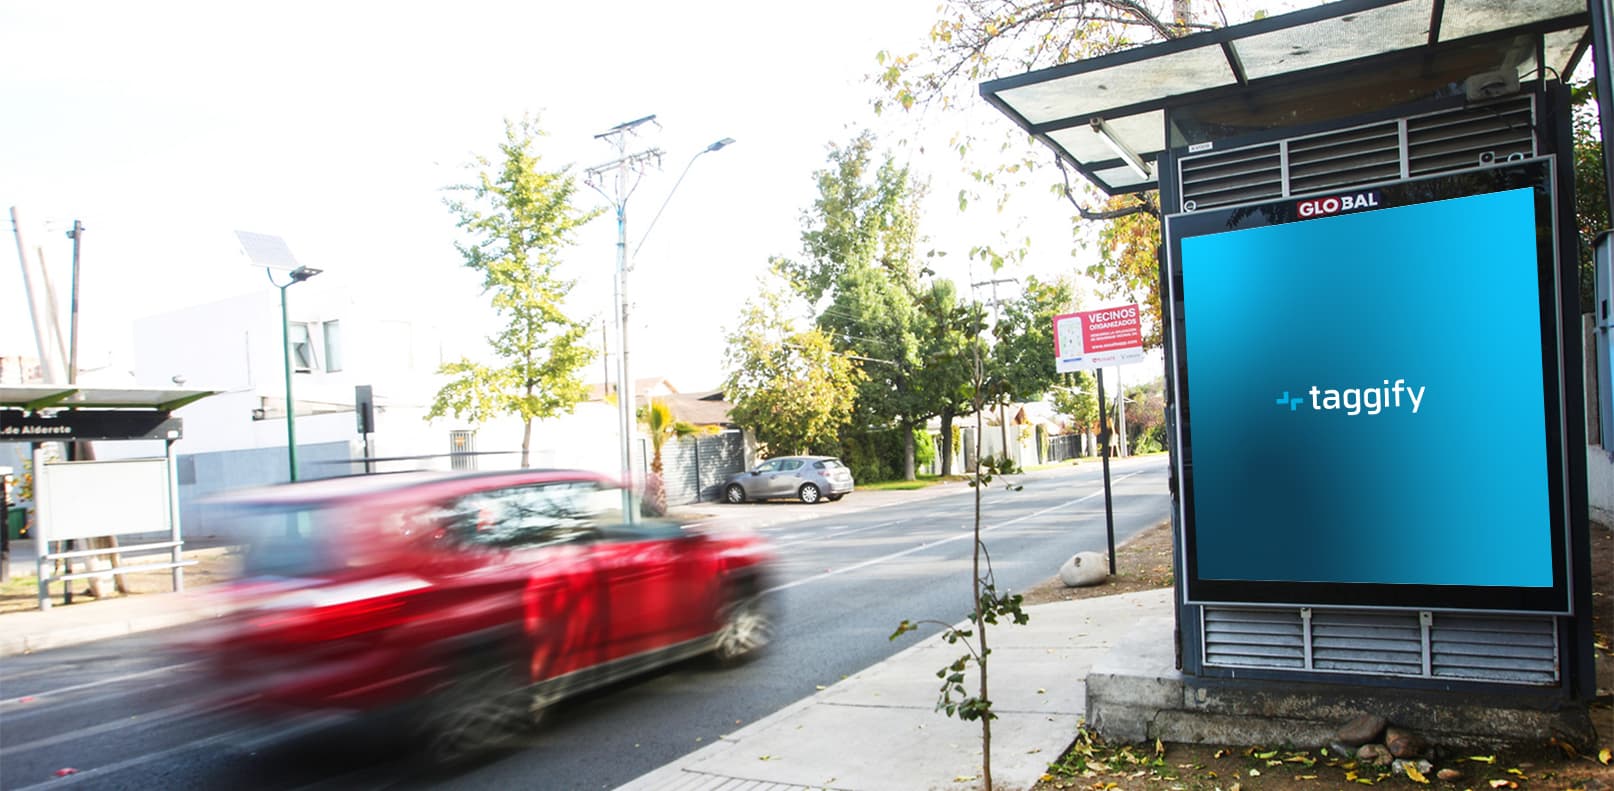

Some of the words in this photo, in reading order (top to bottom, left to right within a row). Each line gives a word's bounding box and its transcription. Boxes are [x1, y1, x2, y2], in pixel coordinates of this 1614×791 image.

[1299, 192, 1378, 217] GLOBAL
[1088, 308, 1136, 323] VECINOS
[1089, 318, 1137, 331] ORGANIZADOS
[1308, 379, 1426, 416] taggify
[22, 425, 72, 434] Alderete
